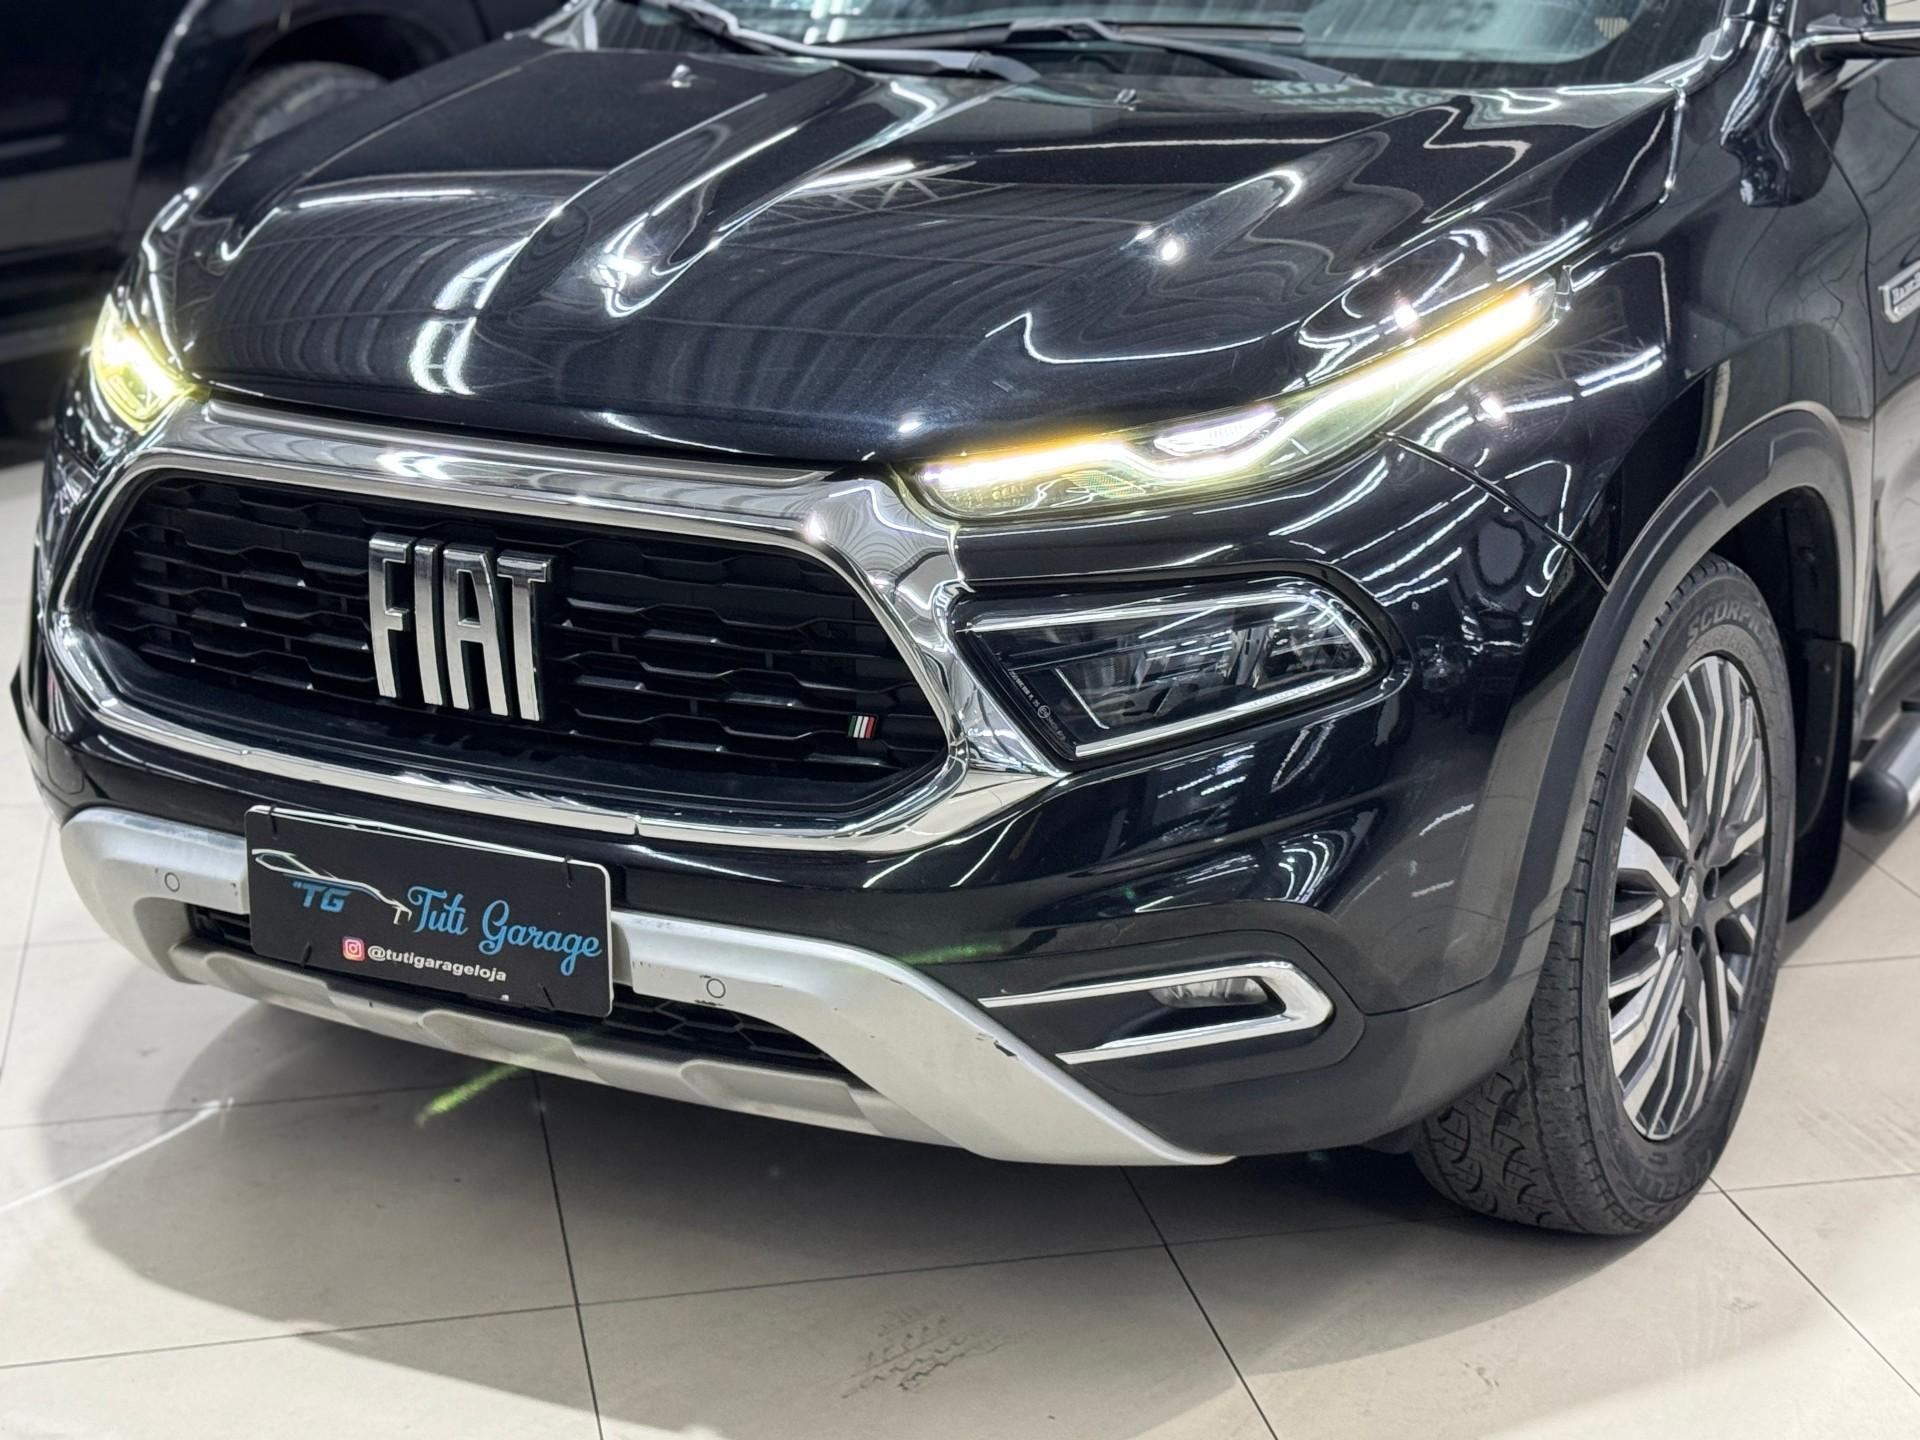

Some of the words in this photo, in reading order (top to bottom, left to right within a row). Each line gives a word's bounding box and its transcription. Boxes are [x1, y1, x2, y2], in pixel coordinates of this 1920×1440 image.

[368, 535, 550, 721] FIAT
[293, 881, 352, 912] TG
[407, 886, 469, 935] Tuti
[478, 900, 602, 976] Garage
[367, 945, 507, 982] @tutigarageloja
